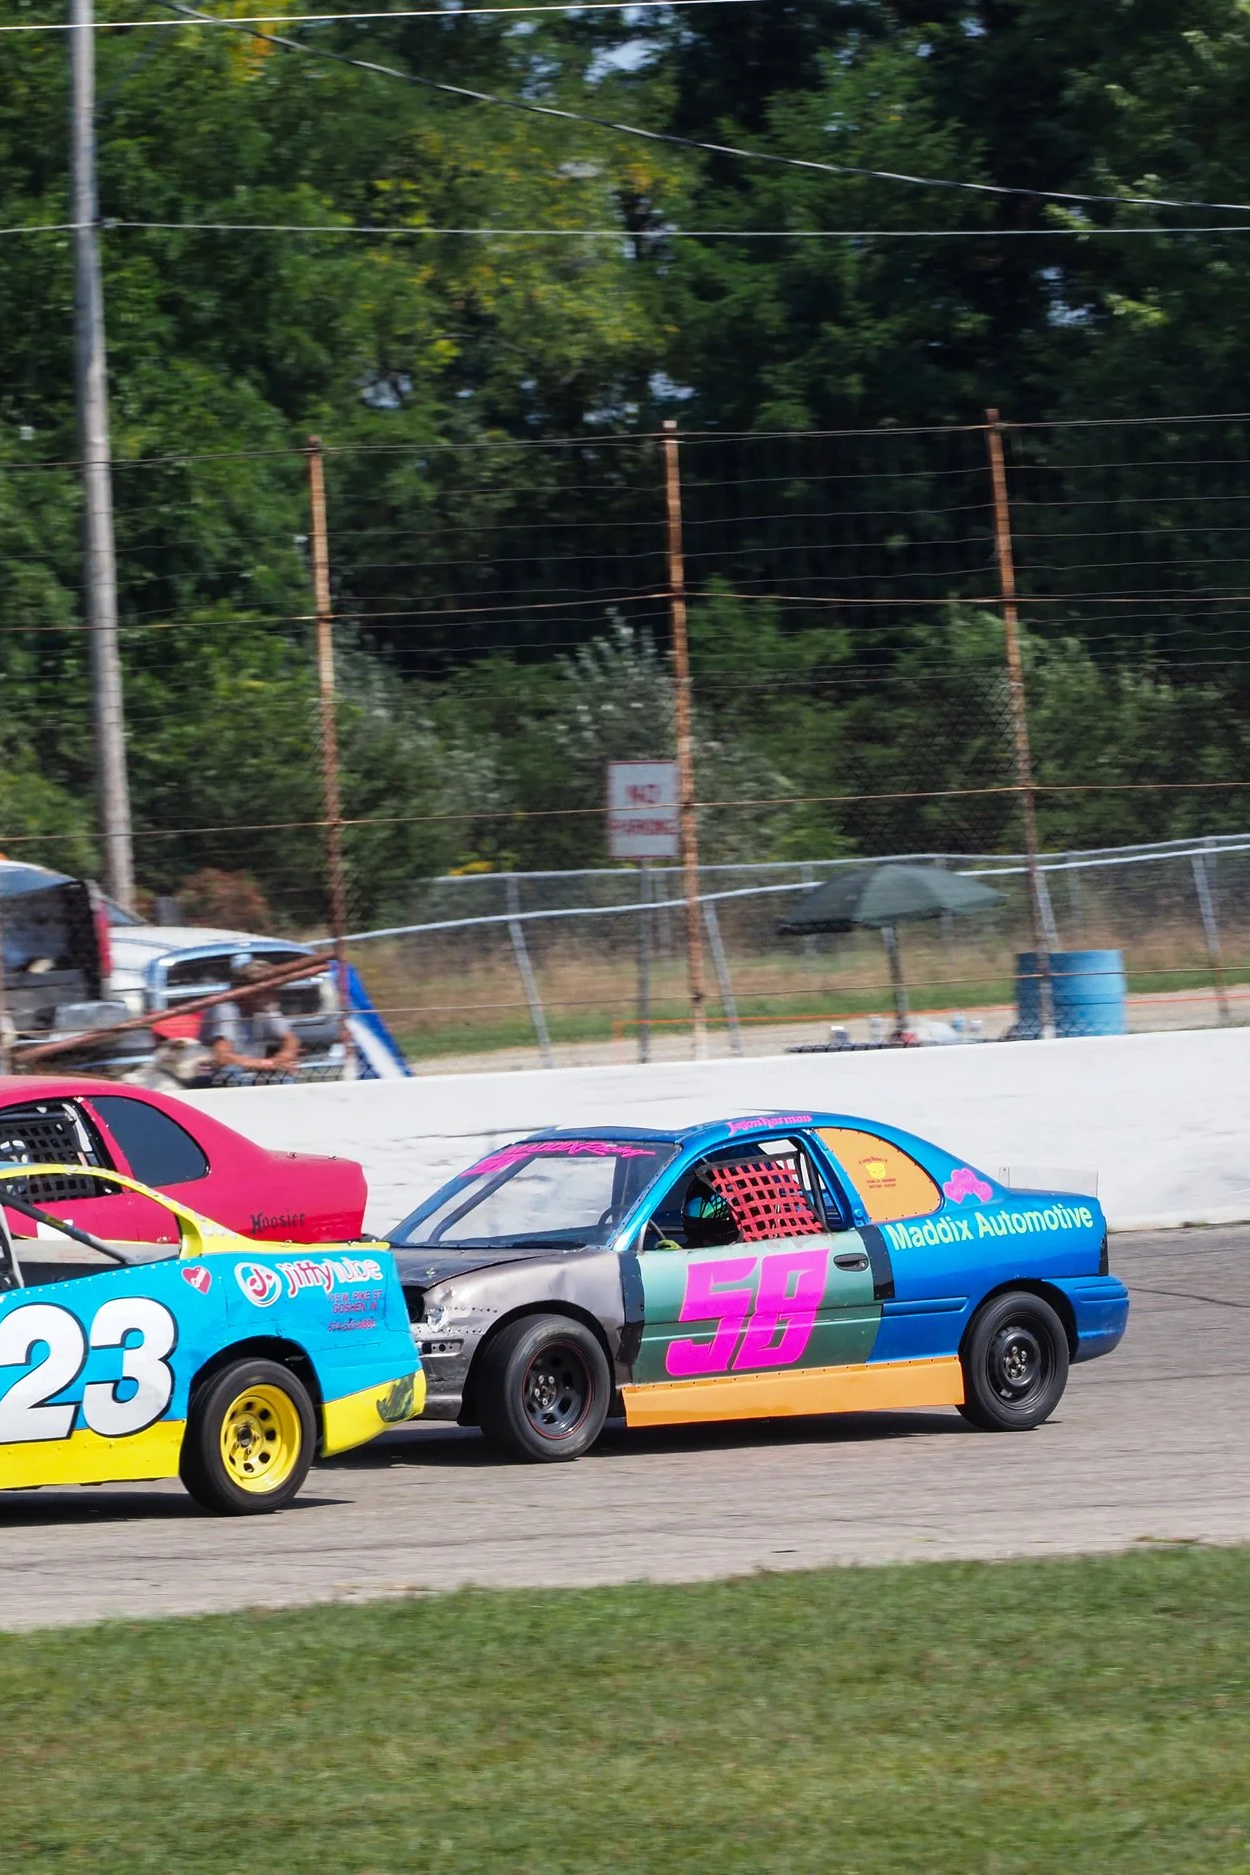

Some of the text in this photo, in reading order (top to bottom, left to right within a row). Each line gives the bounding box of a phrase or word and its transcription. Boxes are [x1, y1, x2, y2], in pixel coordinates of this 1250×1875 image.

[884, 1203, 1094, 1251] Maddix Automotive
[665, 1248, 831, 1377] 58
